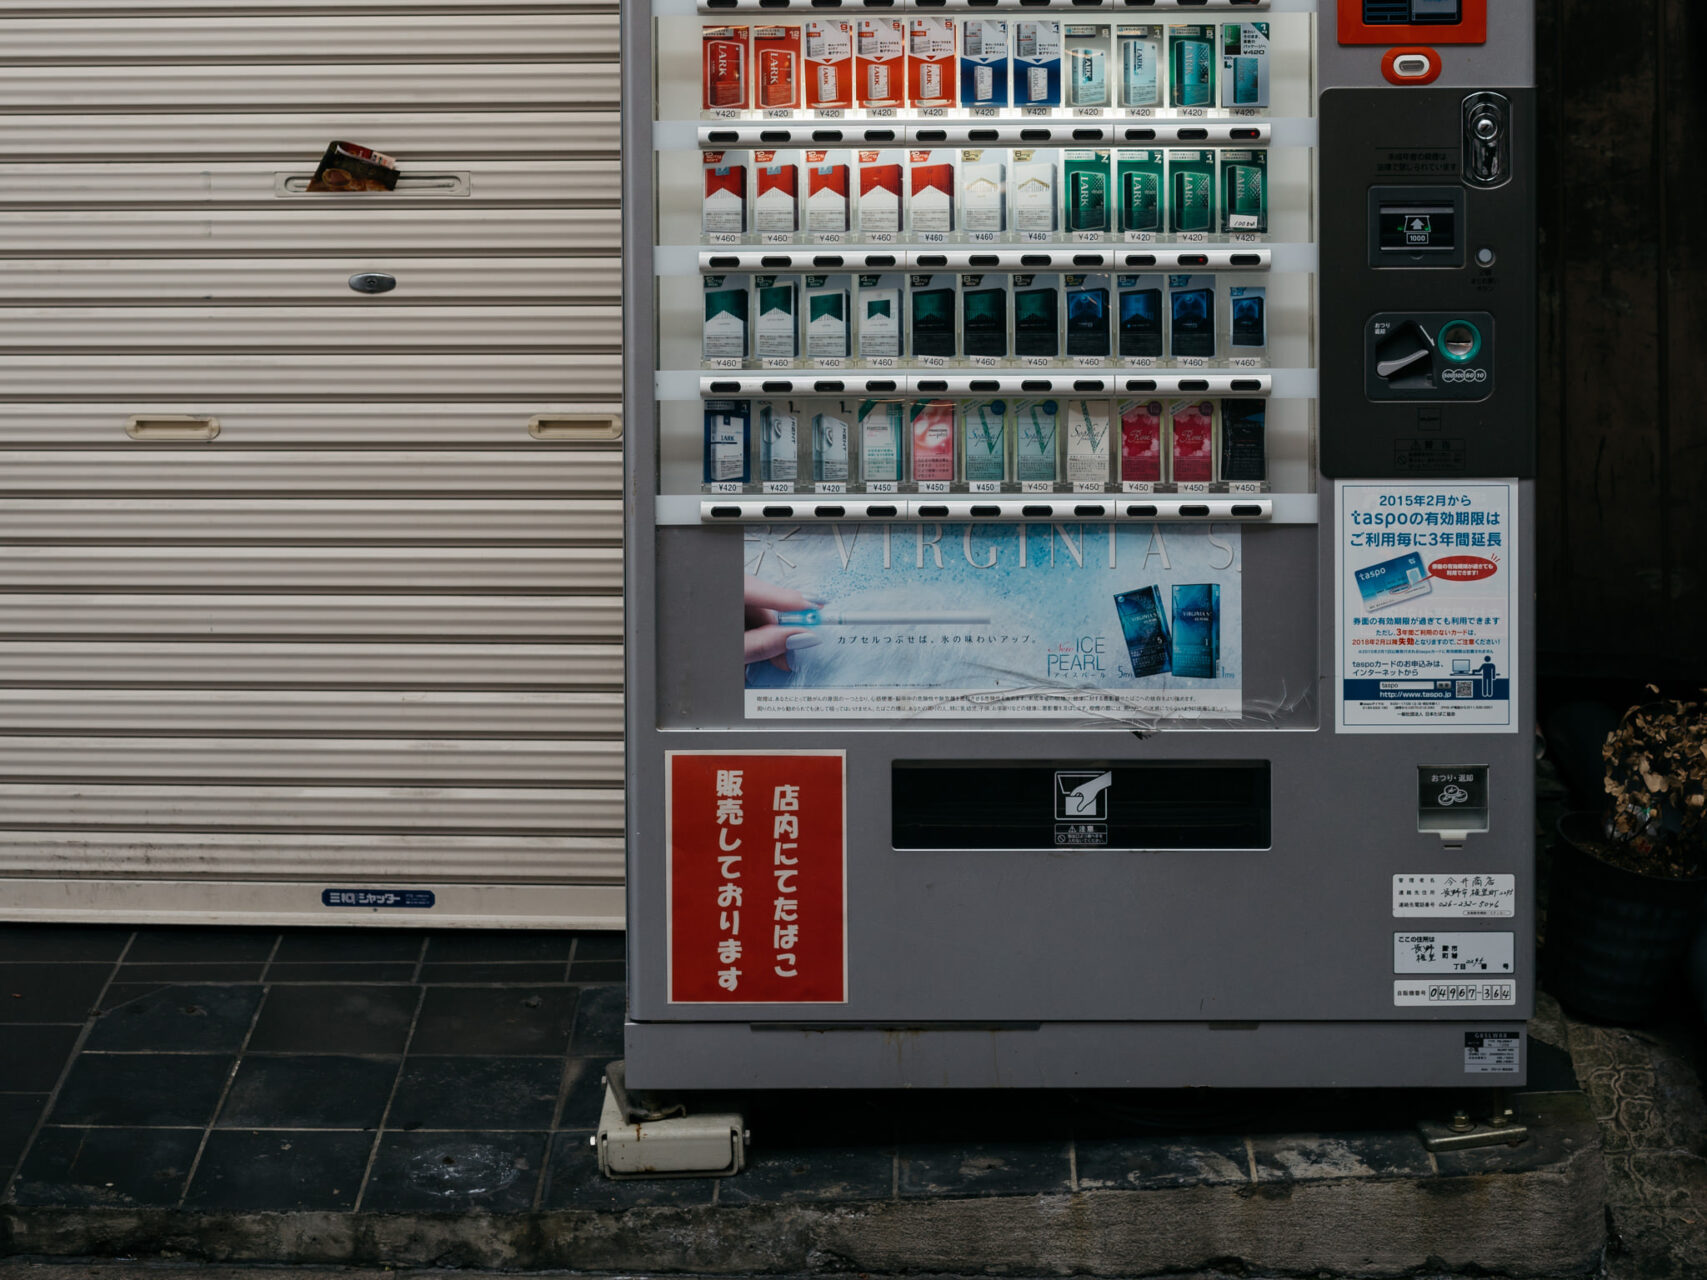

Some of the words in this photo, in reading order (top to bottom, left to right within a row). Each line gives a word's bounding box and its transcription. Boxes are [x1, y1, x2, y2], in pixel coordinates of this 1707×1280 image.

[718, 45, 728, 76] LARK
[770, 53, 779, 84] LARK
[768, 110, 788, 118] ¥420
[819, 110, 839, 118] ¥420
[923, 109, 943, 117] ¥420
[975, 109, 995, 117] ¥420
[1080, 177, 1088, 206] LARK
[1133, 177, 1142, 206] LARK
[1185, 177, 1193, 206] LARK
[716, 234, 735, 242] ¥460
[820, 234, 839, 242] ¥460
[871, 233, 891, 241] ¥460
[976, 233, 993, 241] ¥460
[1131, 233, 1150, 241] ¥420
[1183, 233, 1202, 241] ¥420
[717, 359, 736, 367] ¥460
[768, 359, 788, 367] ¥460
[924, 358, 943, 366] ¥460
[1028, 358, 1048, 366] ¥450
[1079, 358, 1099, 366] ¥460
[1131, 358, 1151, 366] ¥460
[1236, 358, 1255, 366] ¥460
[719, 484, 737, 492] ¥420
[822, 484, 840, 492] ¥420
[873, 483, 891, 491] ¥450
[926, 483, 944, 491] ¥450
[977, 483, 995, 491] ¥450
[1129, 483, 1148, 491] ¥450
[1184, 484, 1204, 492] ¥450
[1236, 484, 1255, 492] ¥450
[1379, 495, 1472, 506] 2015年2月から
[1351, 510, 1500, 528] taspoの有効期限は
[1351, 532, 1502, 547] ご利用毎に3年間延長
[831, 523, 1172, 570] VIRGINIA
[1359, 568, 1386, 581] taspo
[1353, 617, 1500, 625] 券面の有効期限が過ぎても利用できます
[1076, 637, 1105, 654] ICE
[1048, 655, 1106, 676] PEARL
[1431, 774, 1474, 782] おつり・返却
[716, 770, 744, 991] 販売しております
[773, 784, 800, 977] 店内にてたばこ
